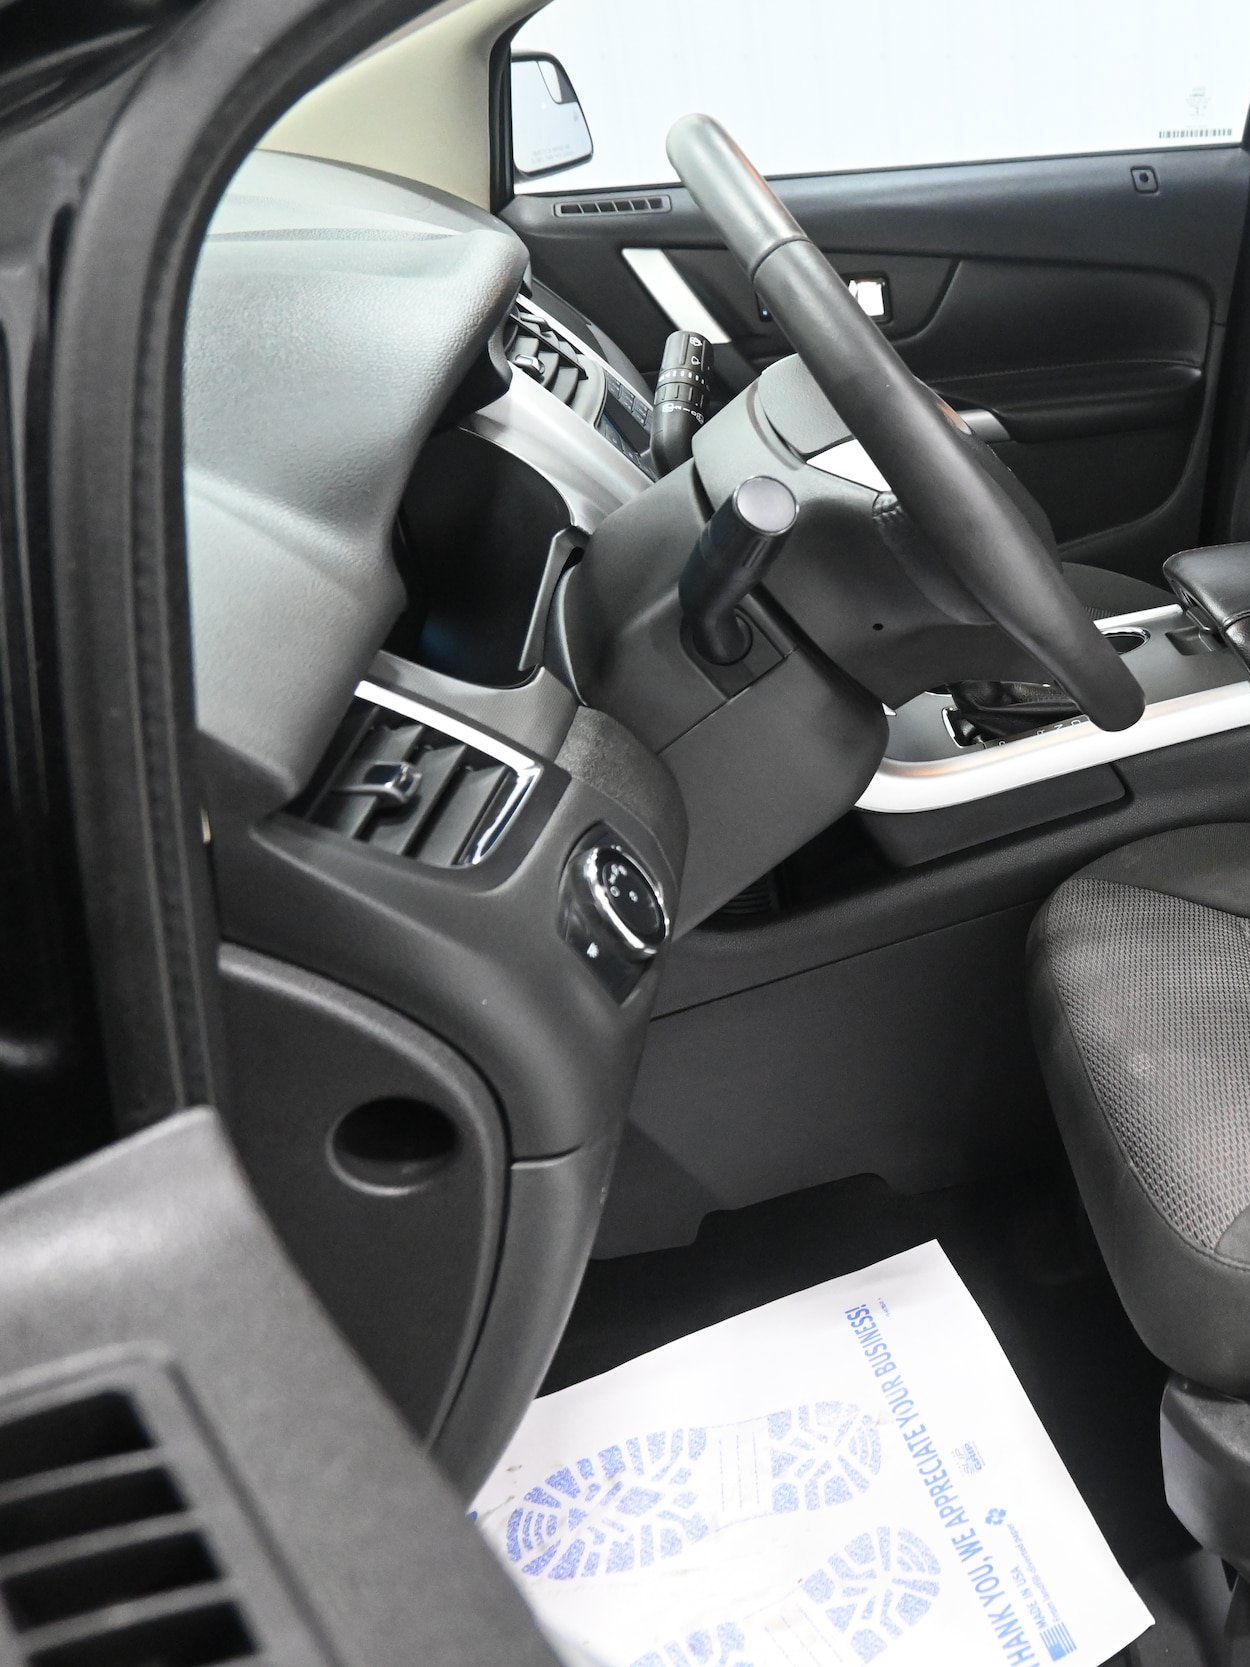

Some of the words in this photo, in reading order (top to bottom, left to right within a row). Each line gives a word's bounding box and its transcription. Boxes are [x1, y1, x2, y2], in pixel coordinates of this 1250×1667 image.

[843, 1300, 898, 1378] BUSINESS!
[877, 1373, 921, 1427] YOUR
[899, 1422, 971, 1531] APPRECIATE
[950, 1526, 985, 1561] WE
[1005, 1521, 1022, 1544] paper
[964, 1553, 1010, 1606] YOU,
[1008, 1564, 1027, 1587] USA
[1020, 1586, 1033, 1600] IN
[1026, 1599, 1048, 1630] MADE
[1045, 1600, 1061, 1622] From
[985, 1602, 1041, 1667] HANK
